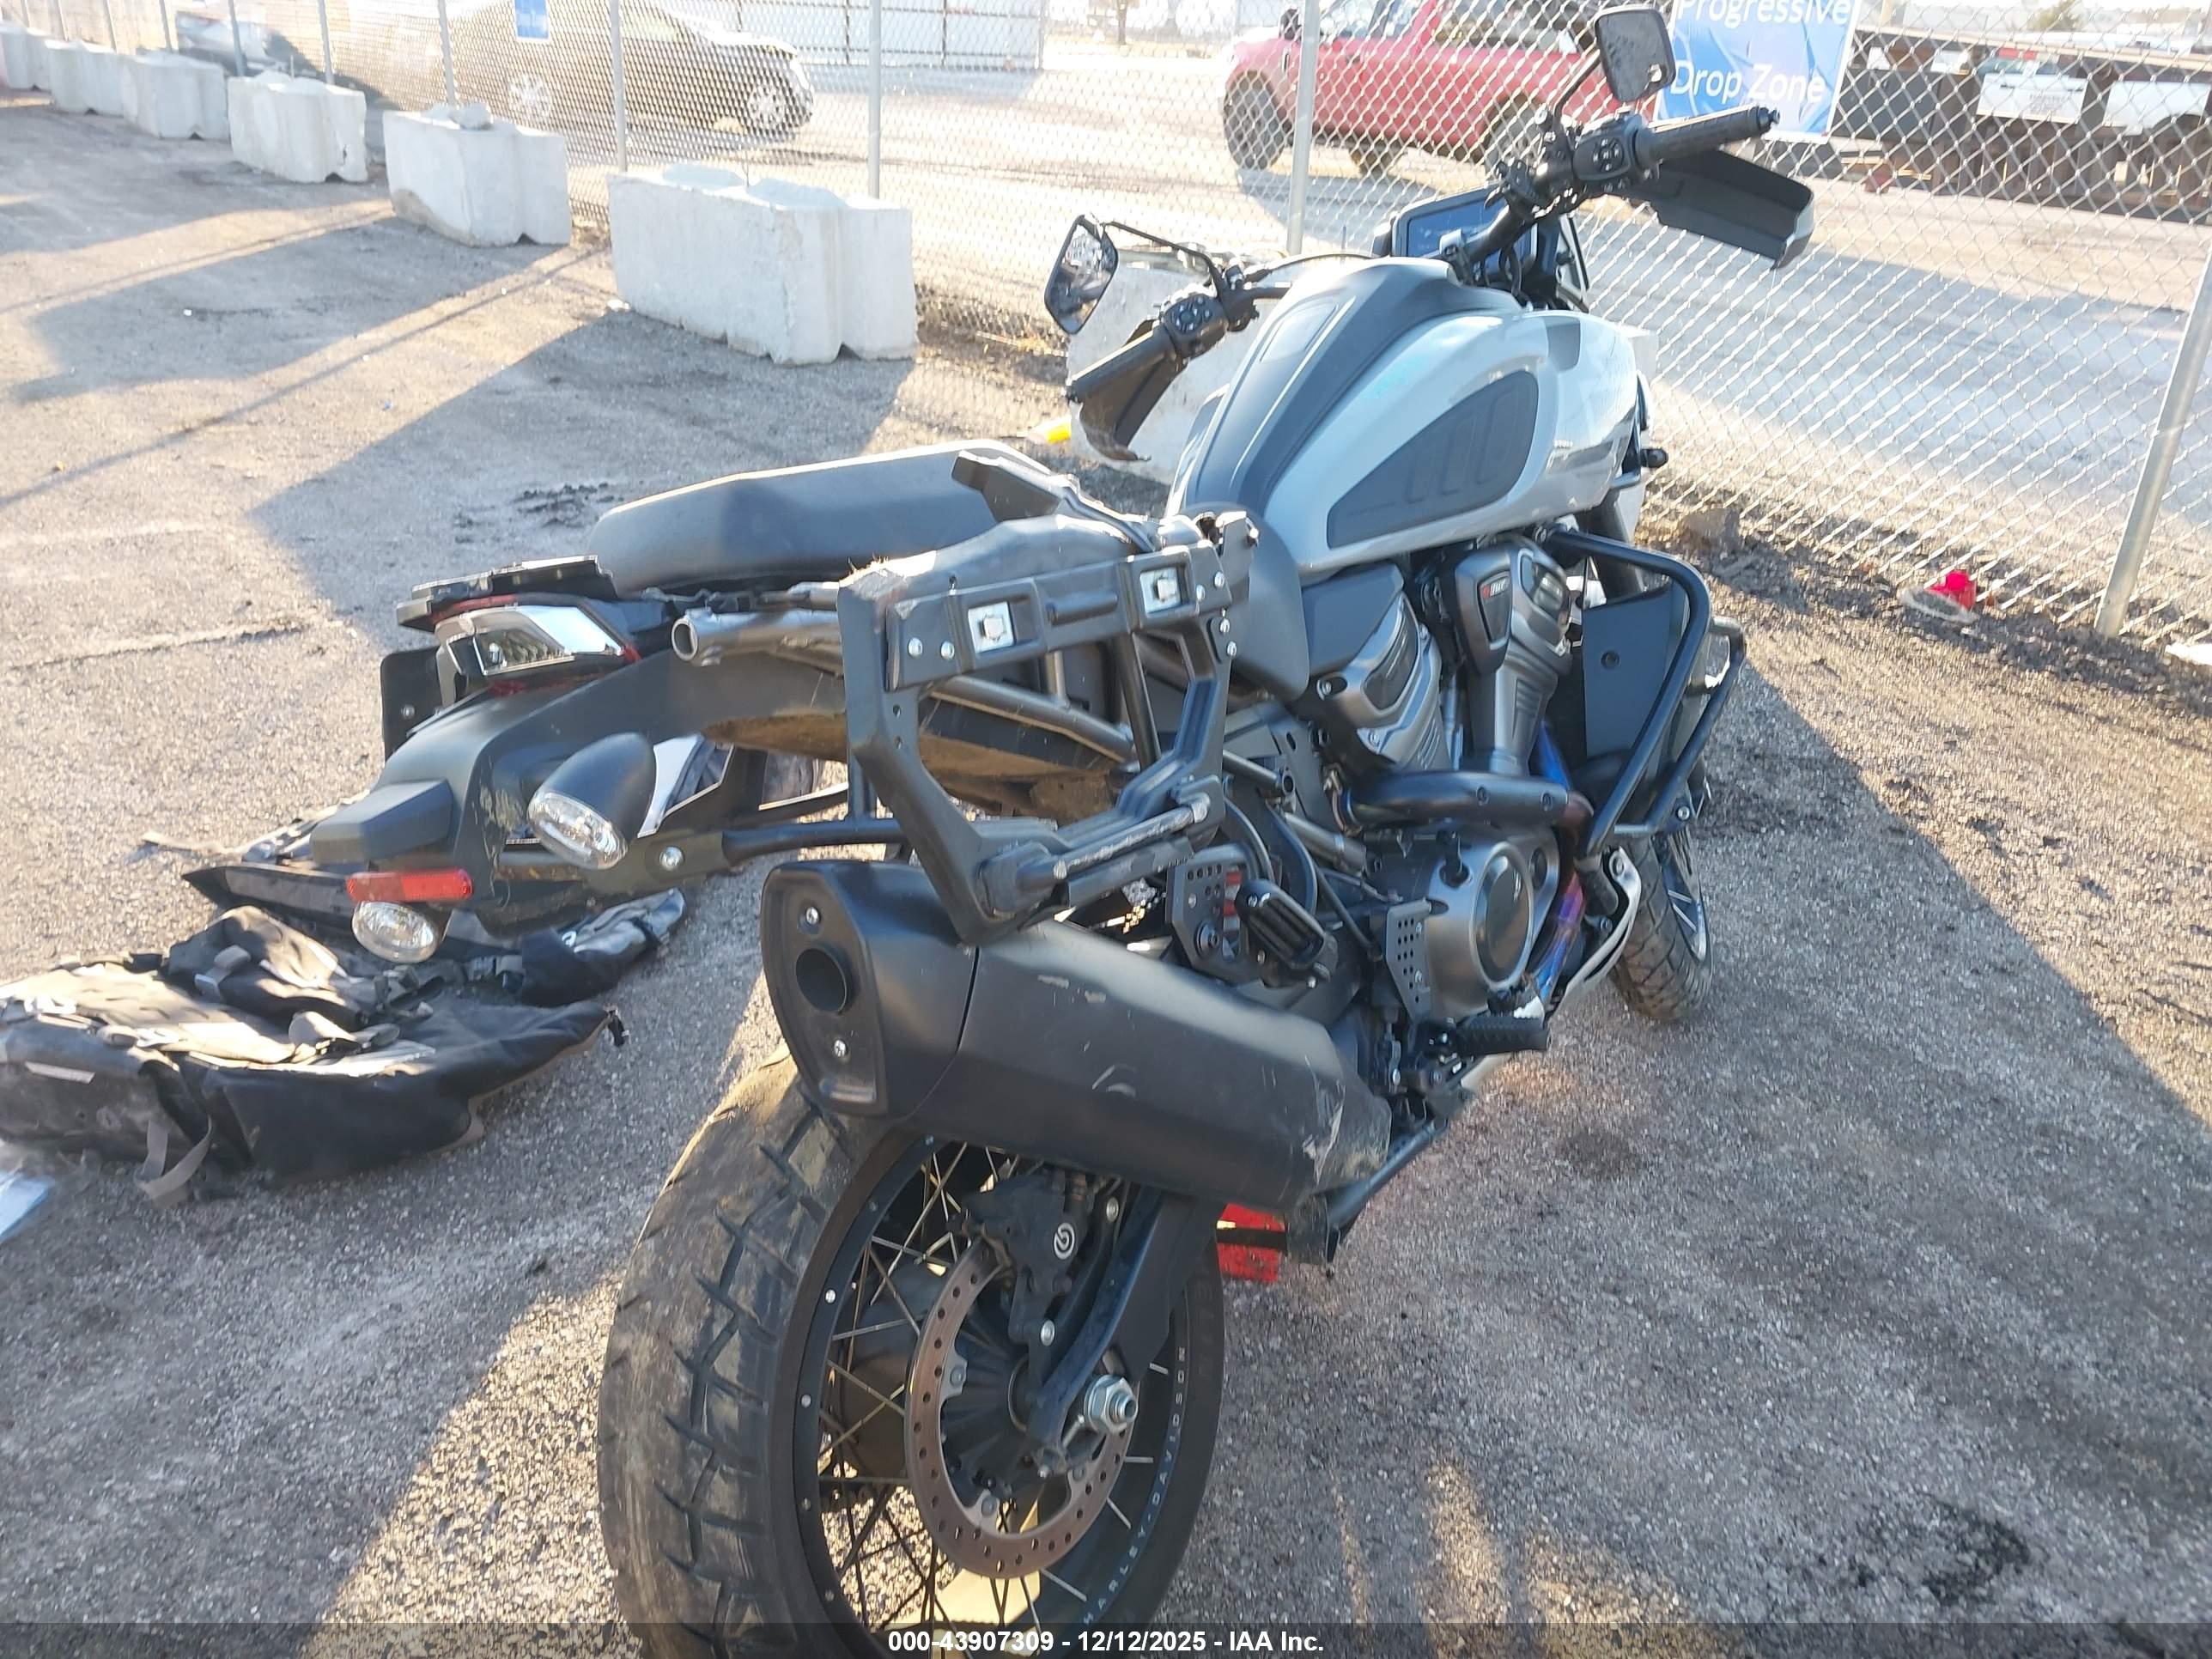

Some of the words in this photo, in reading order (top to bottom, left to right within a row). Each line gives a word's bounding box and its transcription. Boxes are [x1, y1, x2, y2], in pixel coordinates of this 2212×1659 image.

[1677, 0, 1851, 28] Progressive
[1670, 59, 1742, 105] Drop
[1747, 64, 1826, 103] Zone
